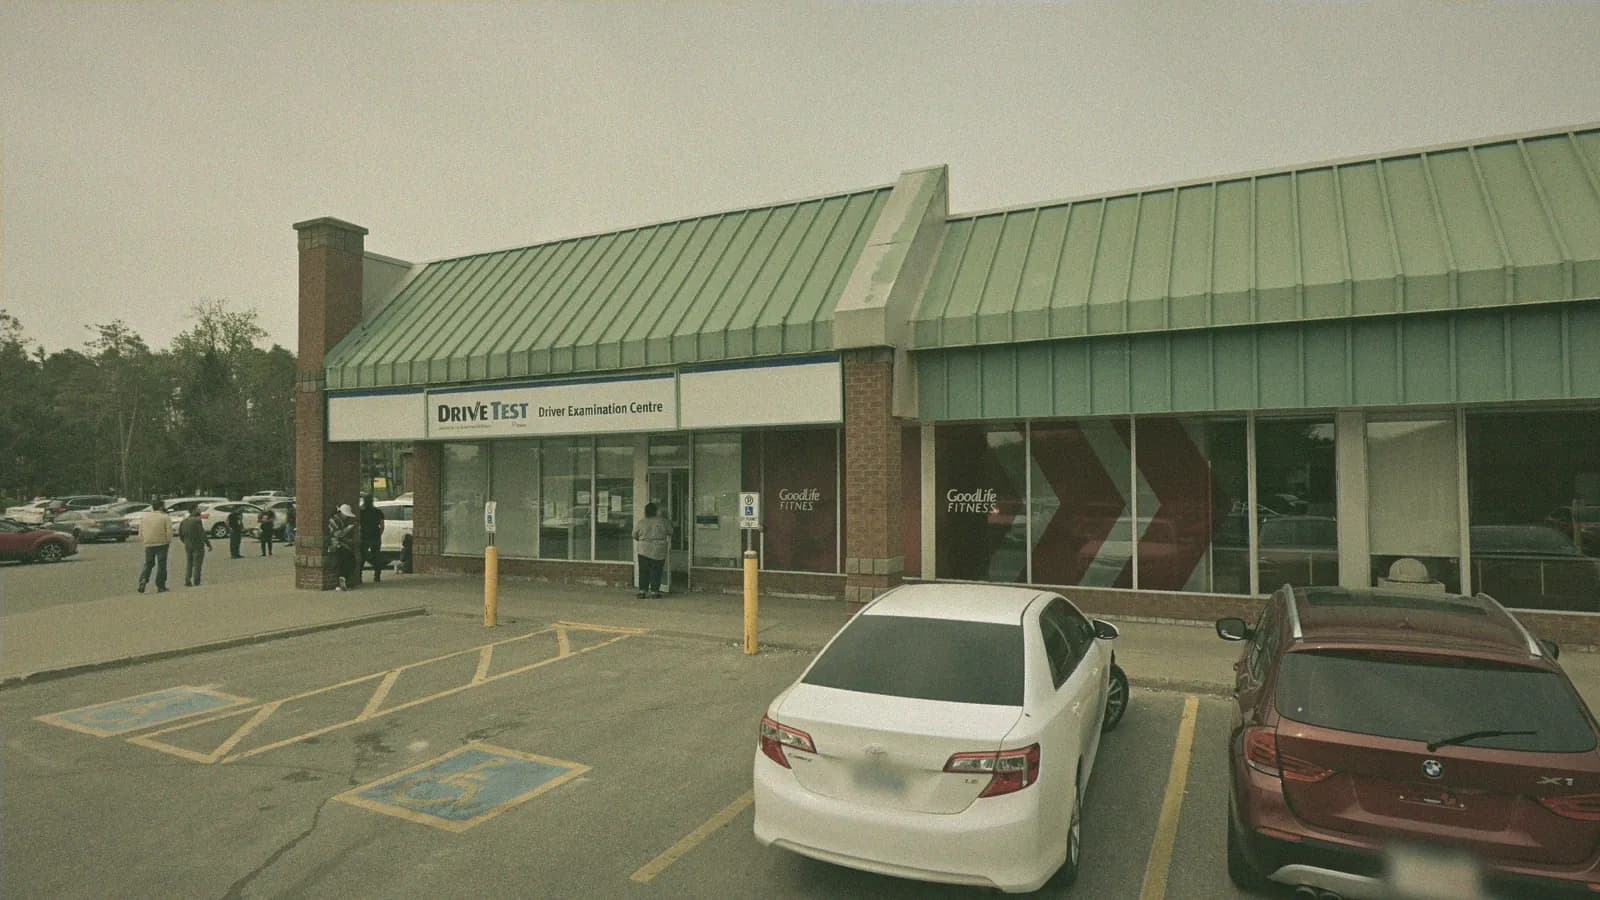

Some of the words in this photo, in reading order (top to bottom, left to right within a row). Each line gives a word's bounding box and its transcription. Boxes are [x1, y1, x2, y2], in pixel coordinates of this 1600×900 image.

[538, 405, 566, 417] Driver
[568, 403, 627, 417] Examination
[630, 401, 663, 414] Centre
[947, 502, 998, 513] FITNESS
